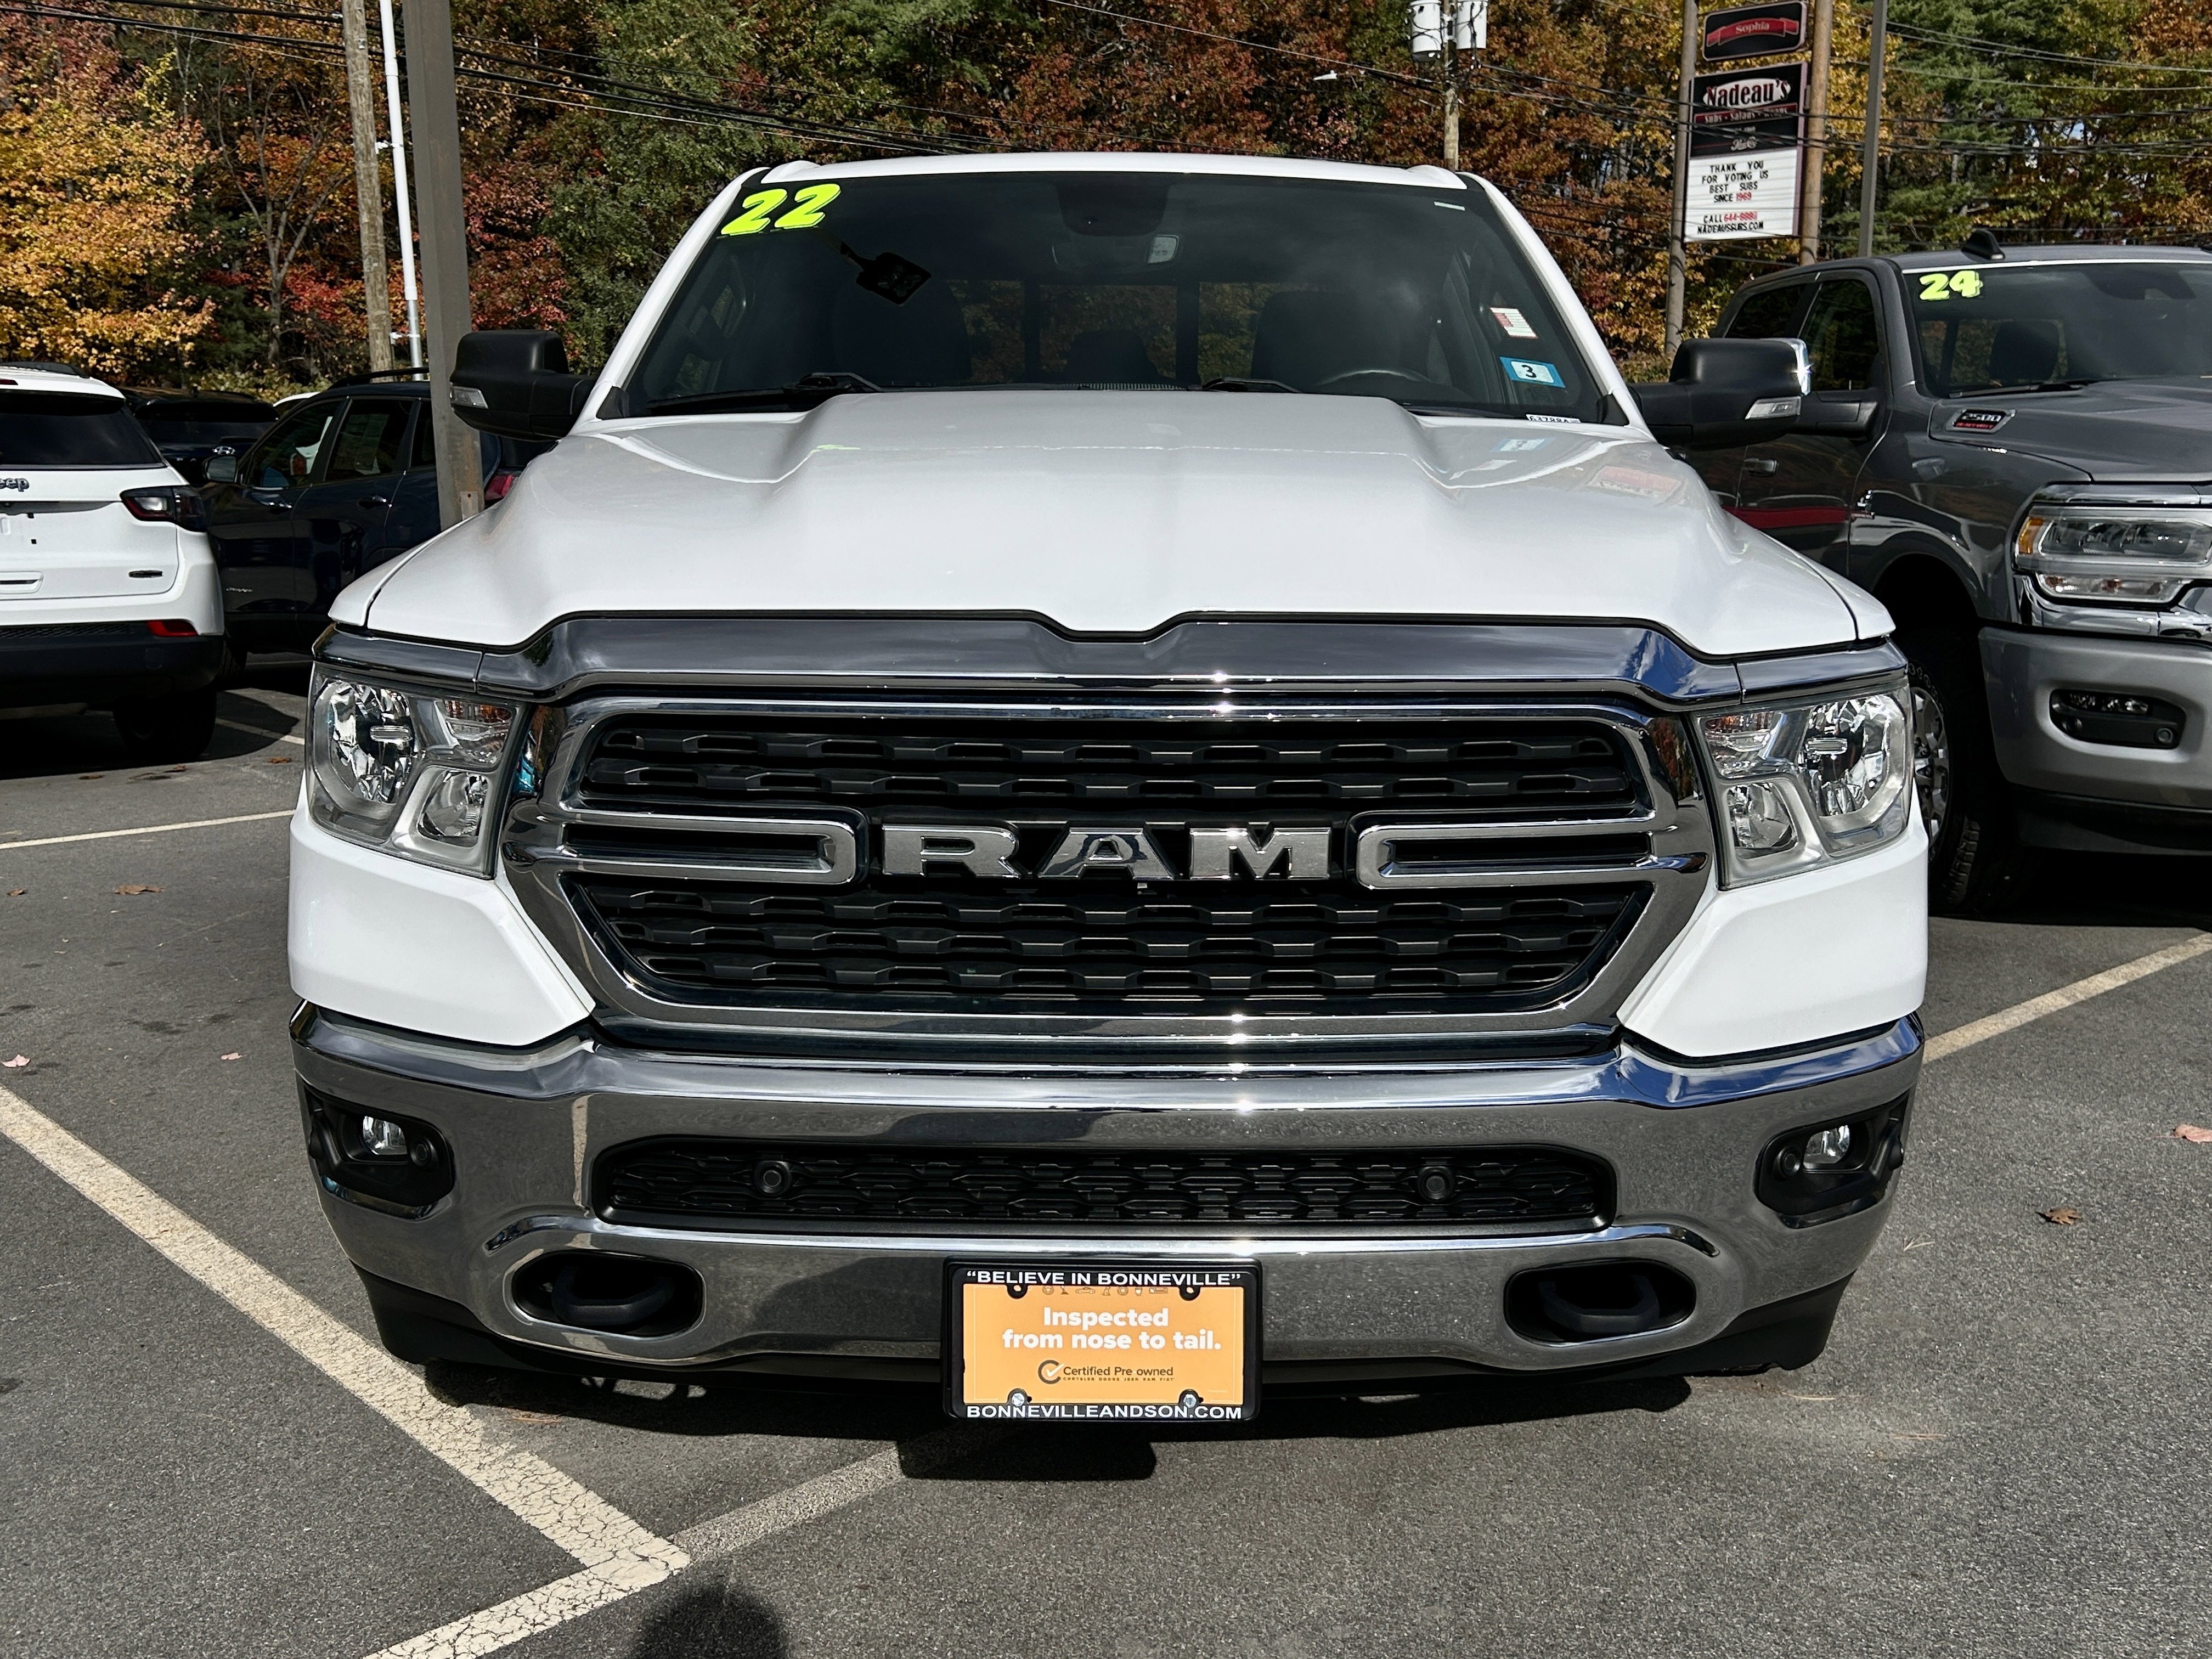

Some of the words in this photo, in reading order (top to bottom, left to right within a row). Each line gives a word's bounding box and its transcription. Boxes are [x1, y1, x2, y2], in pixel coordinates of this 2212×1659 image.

[1706, 78, 1789, 108] Nadeau's
[1710, 163, 1736, 173] THANK
[1747, 160, 1764, 170] YOU
[1702, 175, 1718, 184] FOR
[1725, 172, 1752, 182] VOTING
[1759, 170, 1768, 179] US
[1709, 184, 1728, 194] BEST
[1739, 181, 1758, 191] SUBS
[1714, 193, 1733, 203] SINCE
[721, 183, 841, 236] 22
[1703, 214, 1722, 223] CALL
[1919, 270, 1984, 301] 24
[1521, 364, 1537, 379] 3
[0, 478, 30, 492] eep
[882, 823, 1333, 881] RAM
[1072, 1272, 1091, 1285] IN
[1043, 1307, 1169, 1331] Inspected
[1002, 1329, 1063, 1349] from
[1071, 1332, 1132, 1350] nose
[1139, 1331, 1166, 1350] to
[1173, 1329, 1222, 1350] tail.
[1063, 1366, 1110, 1376] Certified
[1114, 1367, 1133, 1376] Pre
[1136, 1366, 1173, 1376] owned
[967, 1405, 1242, 1420] BONNEVILLEANDSON.COM
